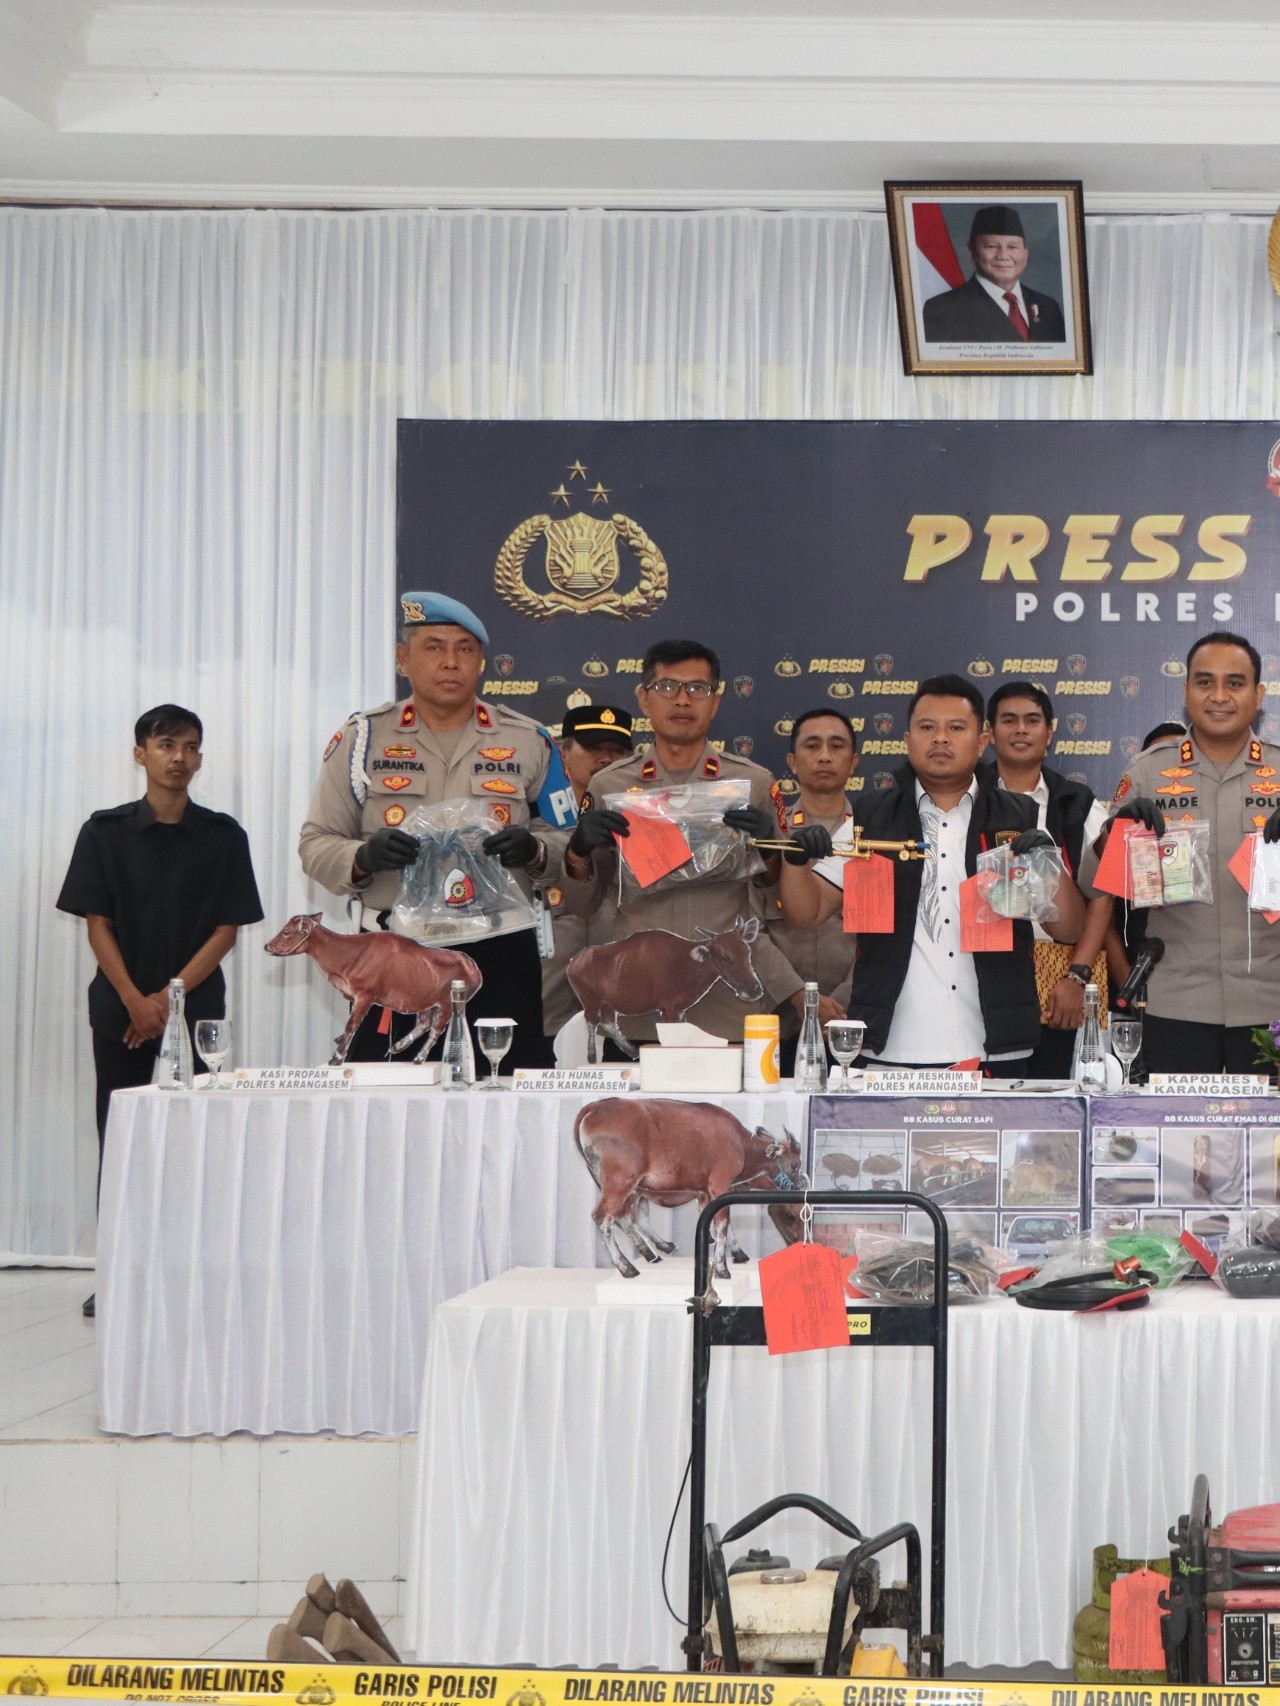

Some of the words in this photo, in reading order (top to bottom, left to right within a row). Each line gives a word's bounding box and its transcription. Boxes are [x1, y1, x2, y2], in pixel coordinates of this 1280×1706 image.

[903, 514, 1252, 585] PRESS
[1014, 592, 1236, 624] POLRES
[808, 658, 865, 673] PRESISI
[1001, 658, 1058, 673] PRESISI
[482, 681, 538, 695] PRESISI
[861, 680, 918, 695] PRESISI
[1055, 680, 1111, 695] PRESISI
[1055, 740, 1111, 755] PRESISI
[372, 760, 425, 772] SURANTIKA
[474, 762, 521, 774] POLRI
[1155, 797, 1198, 810] MADE
[260, 1070, 285, 1079] KASI
[288, 1070, 329, 1079] PROPAM
[541, 1071, 565, 1080] KASI
[568, 1071, 604, 1080] HUMAS
[882, 1072, 915, 1080] KASAT
[918, 1072, 963, 1081] RESKRIM
[1168, 1075, 1251, 1084] KAPOLRES
[236, 1080, 275, 1089] POLRES
[279, 1080, 349, 1089] KARANGASEM
[516, 1081, 554, 1090] POLRES
[557, 1081, 627, 1090] KARANGASEM
[866, 1082, 905, 1091] POLRES
[908, 1082, 978, 1091] KARANGASEM
[1154, 1085, 1264, 1095] KARANGASEM
[903, 1116, 914, 1124] BB
[916, 1116, 944, 1124] KASUS
[945, 1116, 972, 1124] CURAT
[974, 1116, 993, 1124] SAPI
[1164, 1115, 1176, 1123] BB
[1177, 1115, 1205, 1123] KASUS
[1207, 1115, 1234, 1123] CURAT
[1234, 1115, 1257, 1123] EMAS
[1258, 1115, 1267, 1123] DI
[67, 1664, 174, 1690] DILARANG
[180, 1667, 286, 1693] MELINTAS
[354, 1672, 420, 1697] GARIS
[427, 1675, 498, 1699] POLISI
[563, 1678, 667, 1702] DILARANG
[672, 1681, 775, 1705] MELINTAS
[843, 1685, 908, 1706] GARIS
